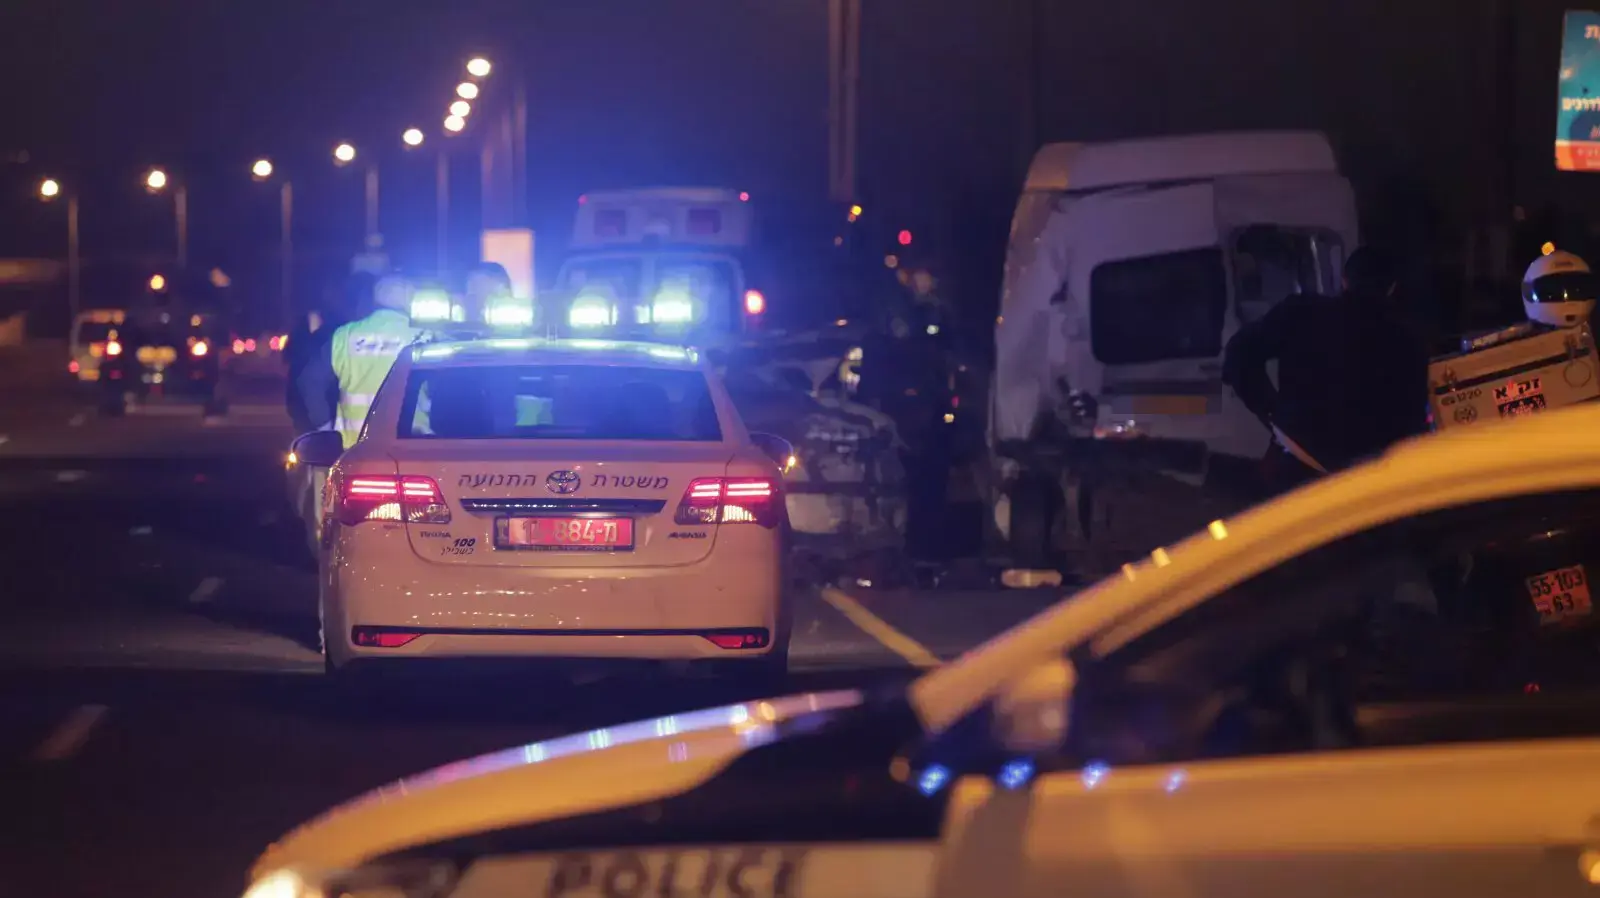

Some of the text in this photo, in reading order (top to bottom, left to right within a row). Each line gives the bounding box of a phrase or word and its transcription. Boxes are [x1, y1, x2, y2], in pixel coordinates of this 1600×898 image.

[458, 474, 669, 489] משטרת התנועה
[453, 538, 476, 547] 100
